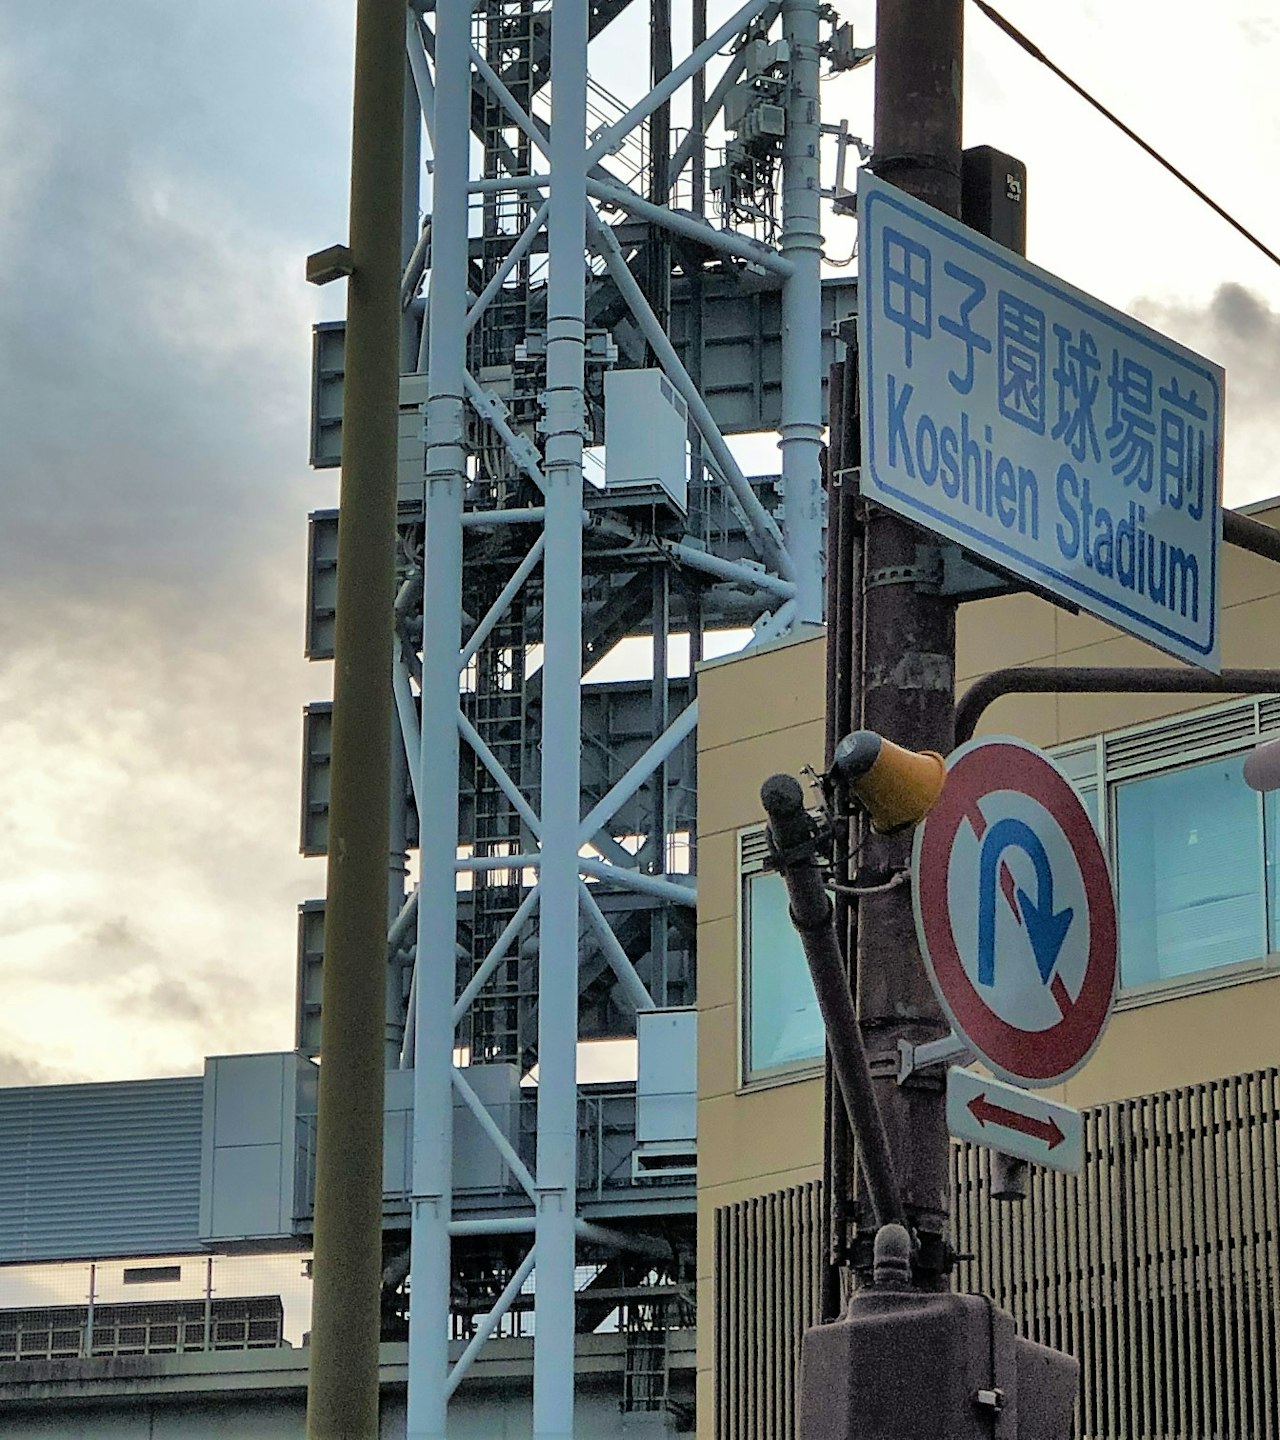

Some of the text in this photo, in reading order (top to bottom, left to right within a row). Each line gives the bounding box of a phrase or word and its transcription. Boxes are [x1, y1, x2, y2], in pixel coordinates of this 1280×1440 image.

[881, 225, 1209, 522] 甲子園球場前
[886, 372, 1201, 624] Koshien Stadium
